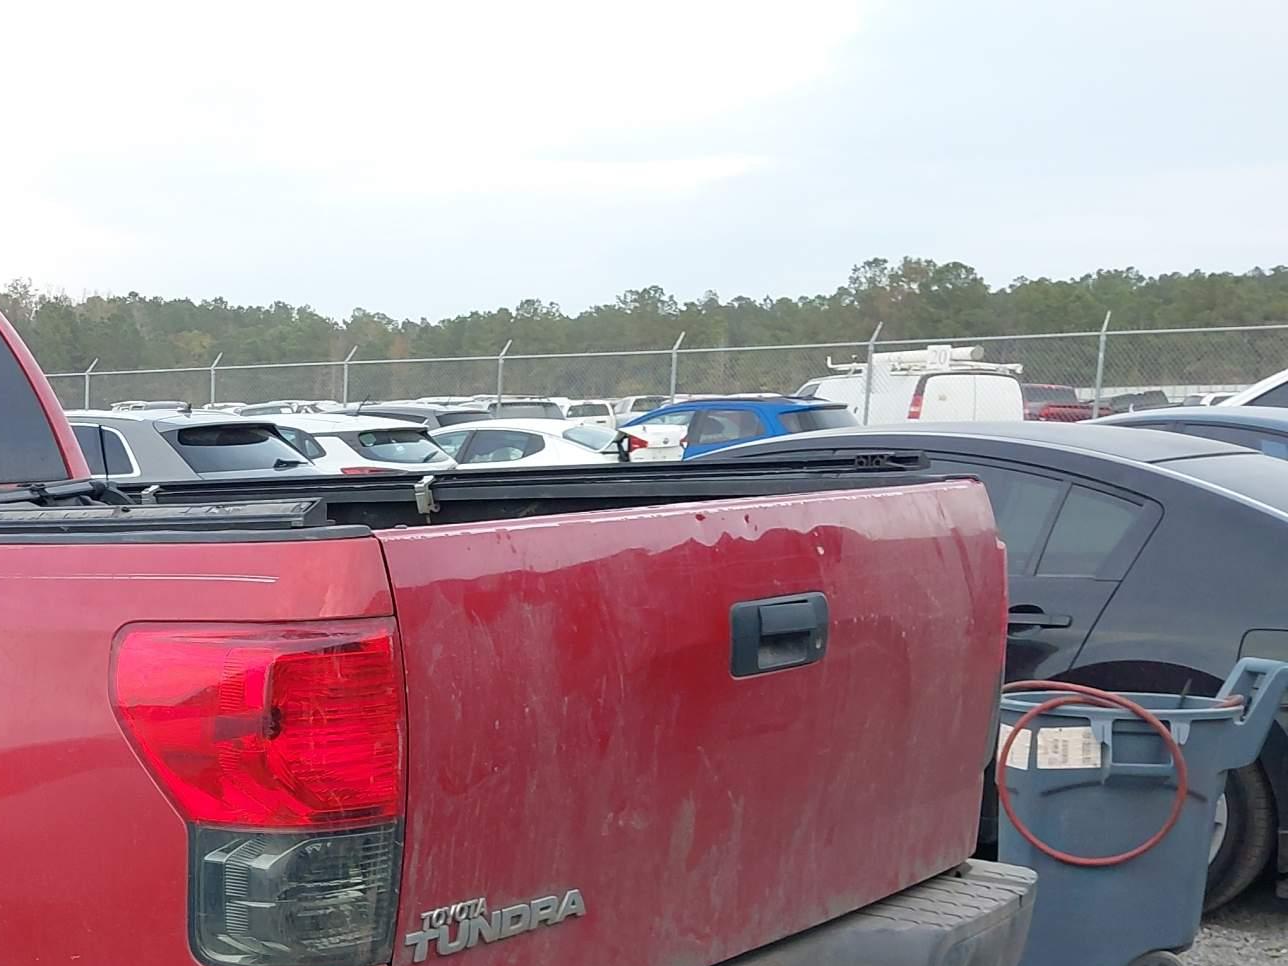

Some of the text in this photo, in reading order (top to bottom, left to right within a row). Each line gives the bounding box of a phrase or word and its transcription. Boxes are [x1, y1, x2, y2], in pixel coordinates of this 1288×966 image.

[929, 350, 948, 366] 20
[405, 888, 586, 963] TUNDRA
[421, 897, 487, 930] TOYOTA
